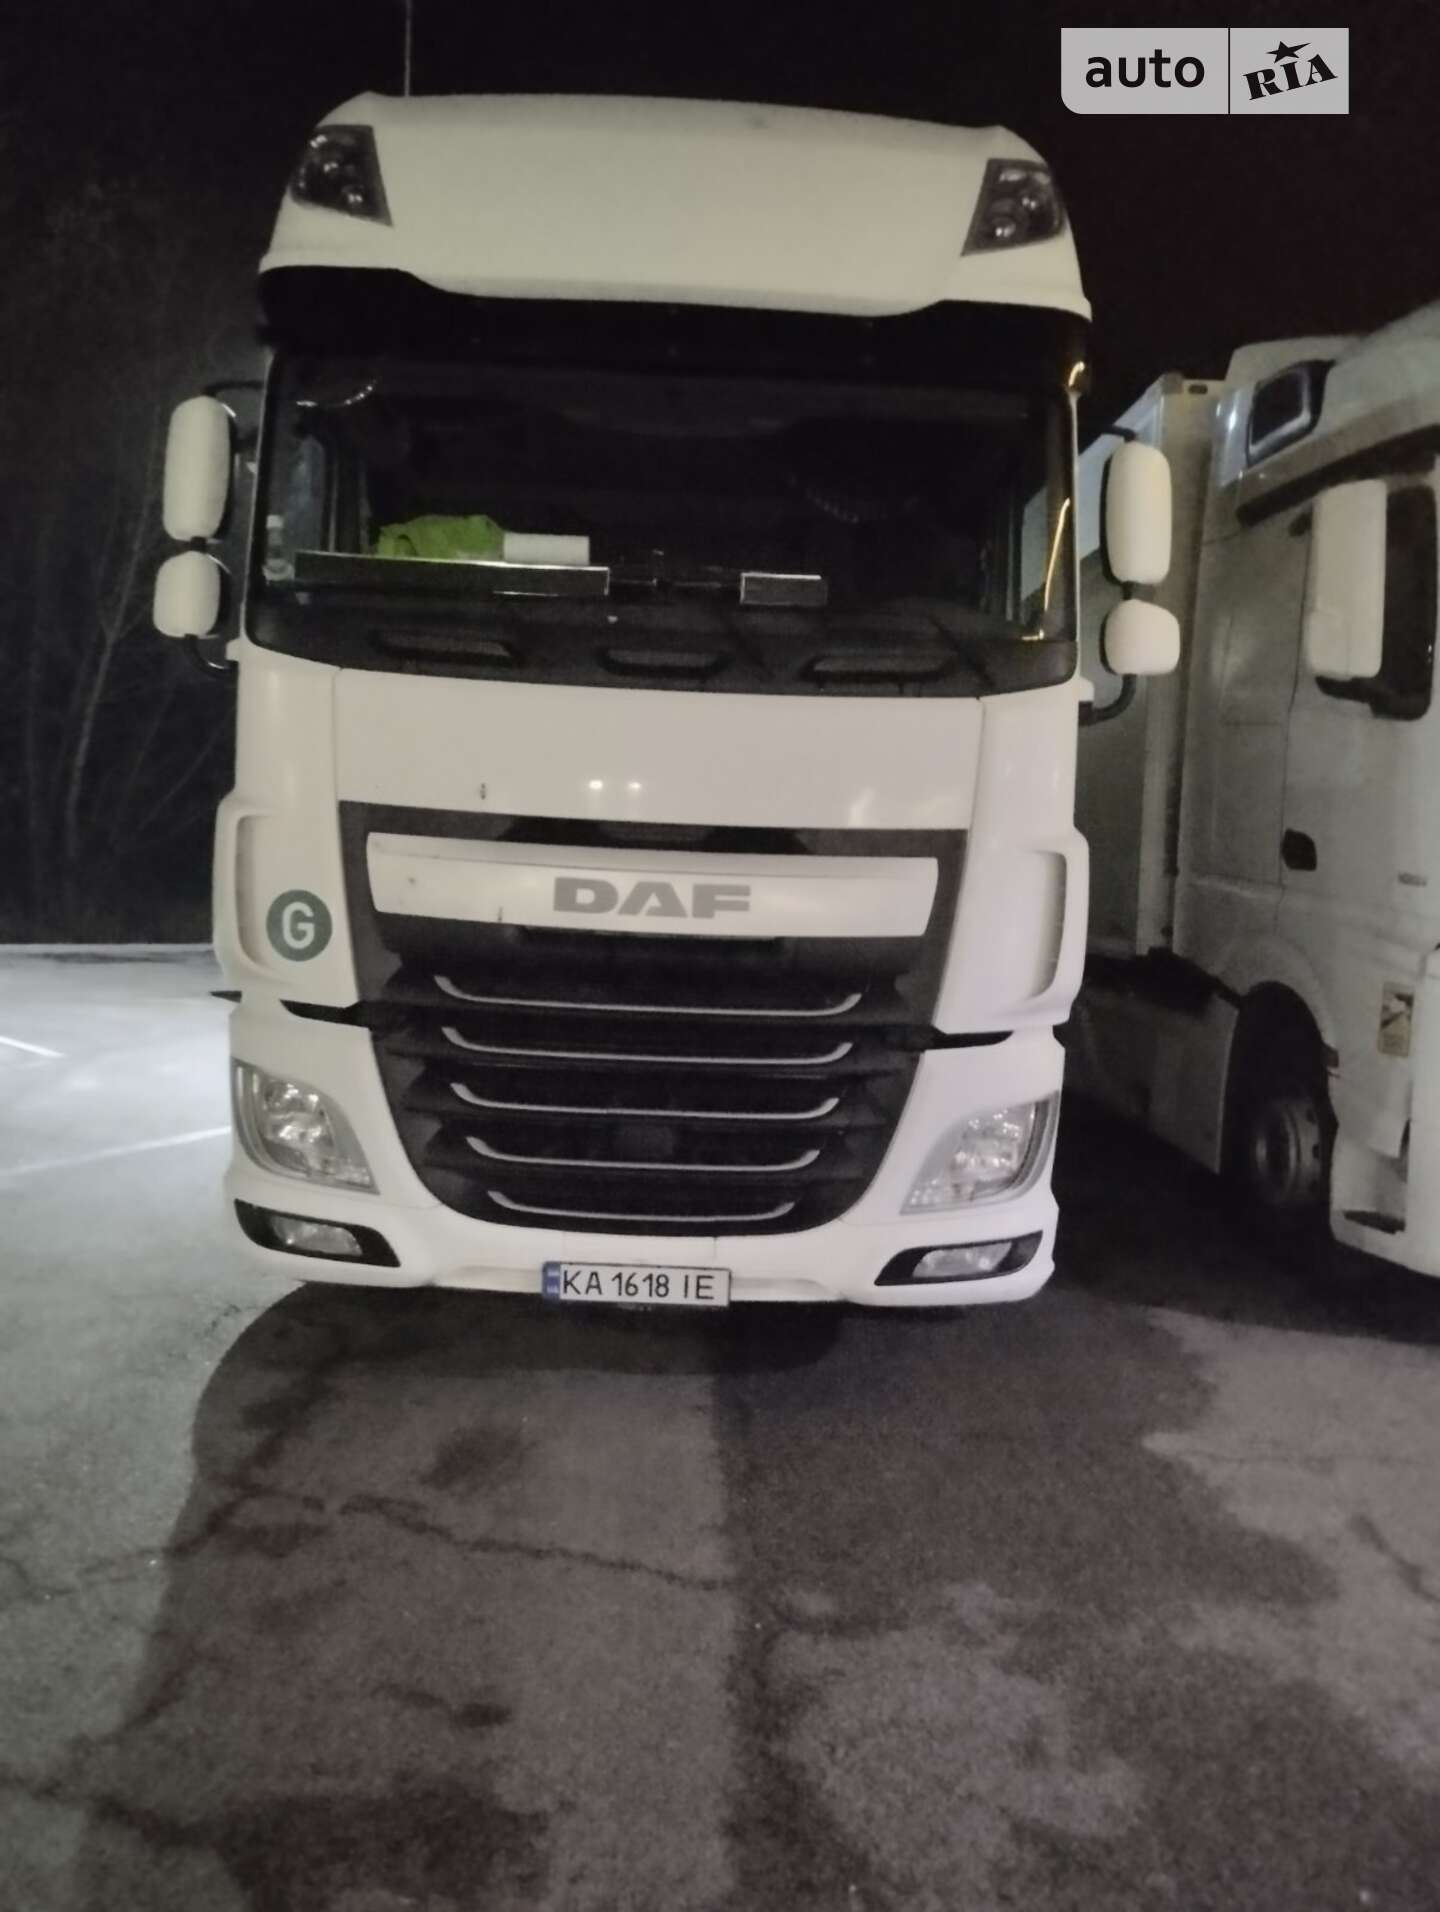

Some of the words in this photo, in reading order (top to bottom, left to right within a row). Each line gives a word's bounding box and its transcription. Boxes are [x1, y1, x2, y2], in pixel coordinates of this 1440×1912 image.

[553, 876, 751, 919] DAF
[282, 901, 315, 949] G
[562, 1269, 603, 1296] KA
[611, 1272, 670, 1298] 1618
[683, 1274, 715, 1300] IE
